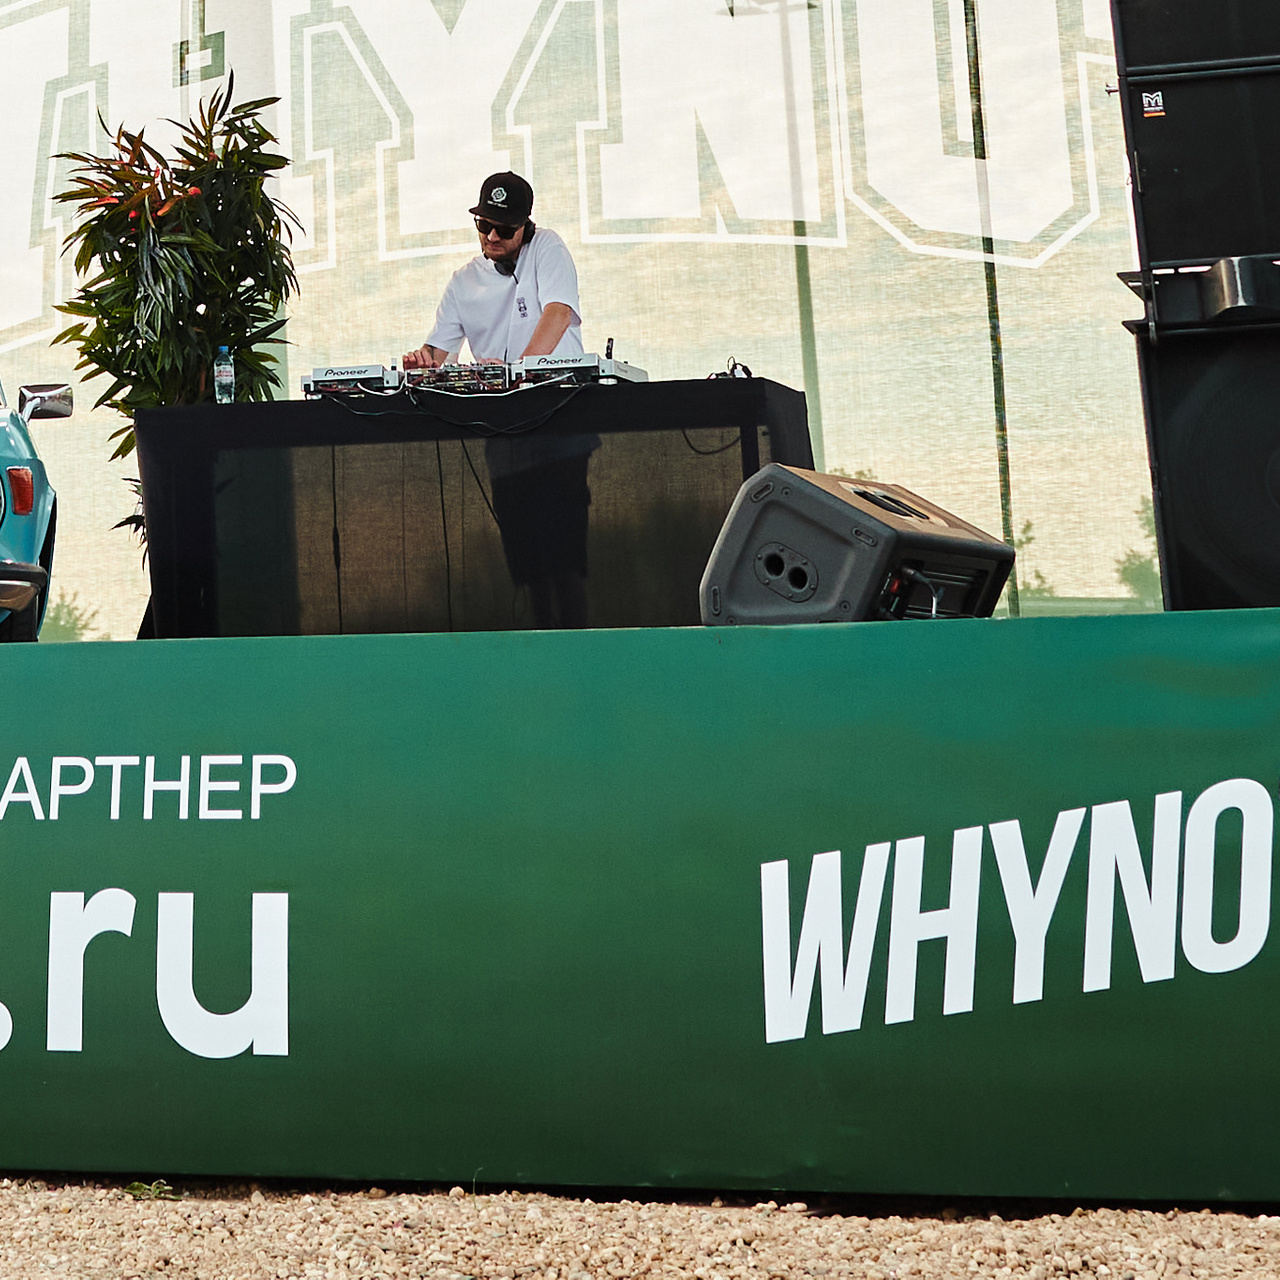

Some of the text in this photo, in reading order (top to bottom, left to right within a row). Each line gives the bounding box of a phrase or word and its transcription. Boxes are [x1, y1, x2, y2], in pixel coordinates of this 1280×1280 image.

[537, 357, 583, 365] Pioneer
[324, 369, 368, 377] Pioneer
[761, 778, 1274, 1044] WHYNO
